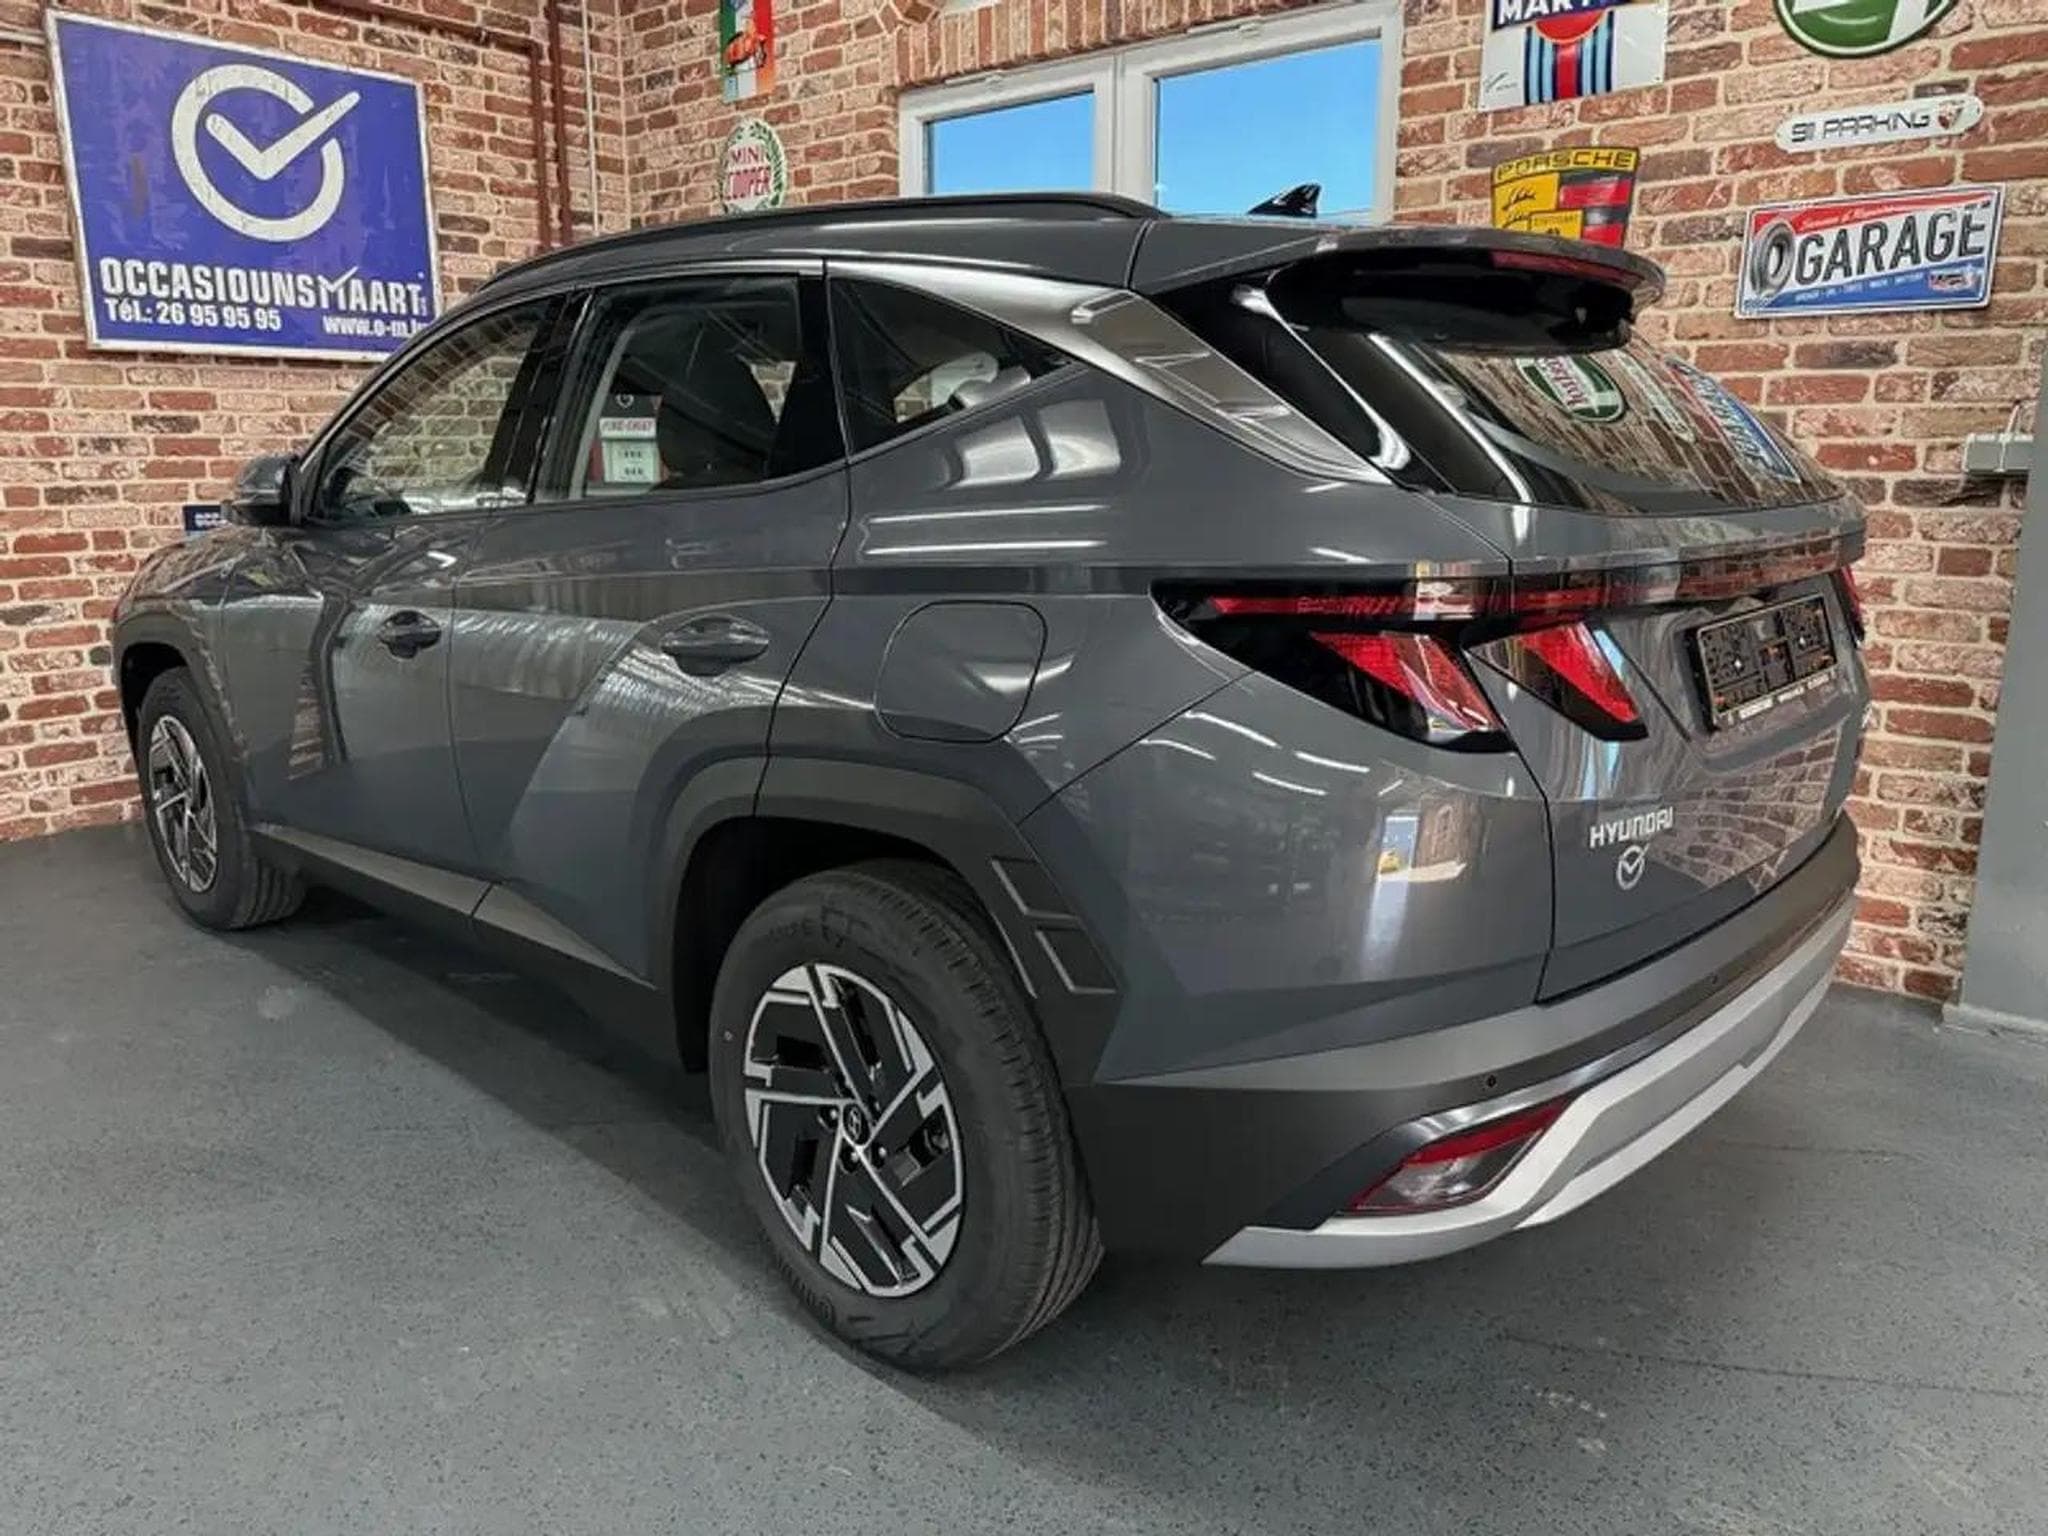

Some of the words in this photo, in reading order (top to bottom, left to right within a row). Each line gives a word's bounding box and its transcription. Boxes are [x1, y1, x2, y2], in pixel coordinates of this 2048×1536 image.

[1823, 112, 1930, 139] PARKING
[1497, 151, 1633, 181] PORSCHE
[1794, 202, 1990, 287] GARAGE
[99, 256, 423, 316] OCCASIOUNSMAART
[156, 301, 185, 325] 26
[190, 303, 219, 327] 95
[222, 305, 251, 329] 95
[254, 307, 282, 331] 95
[1589, 806, 1674, 849] HYUNDAI
